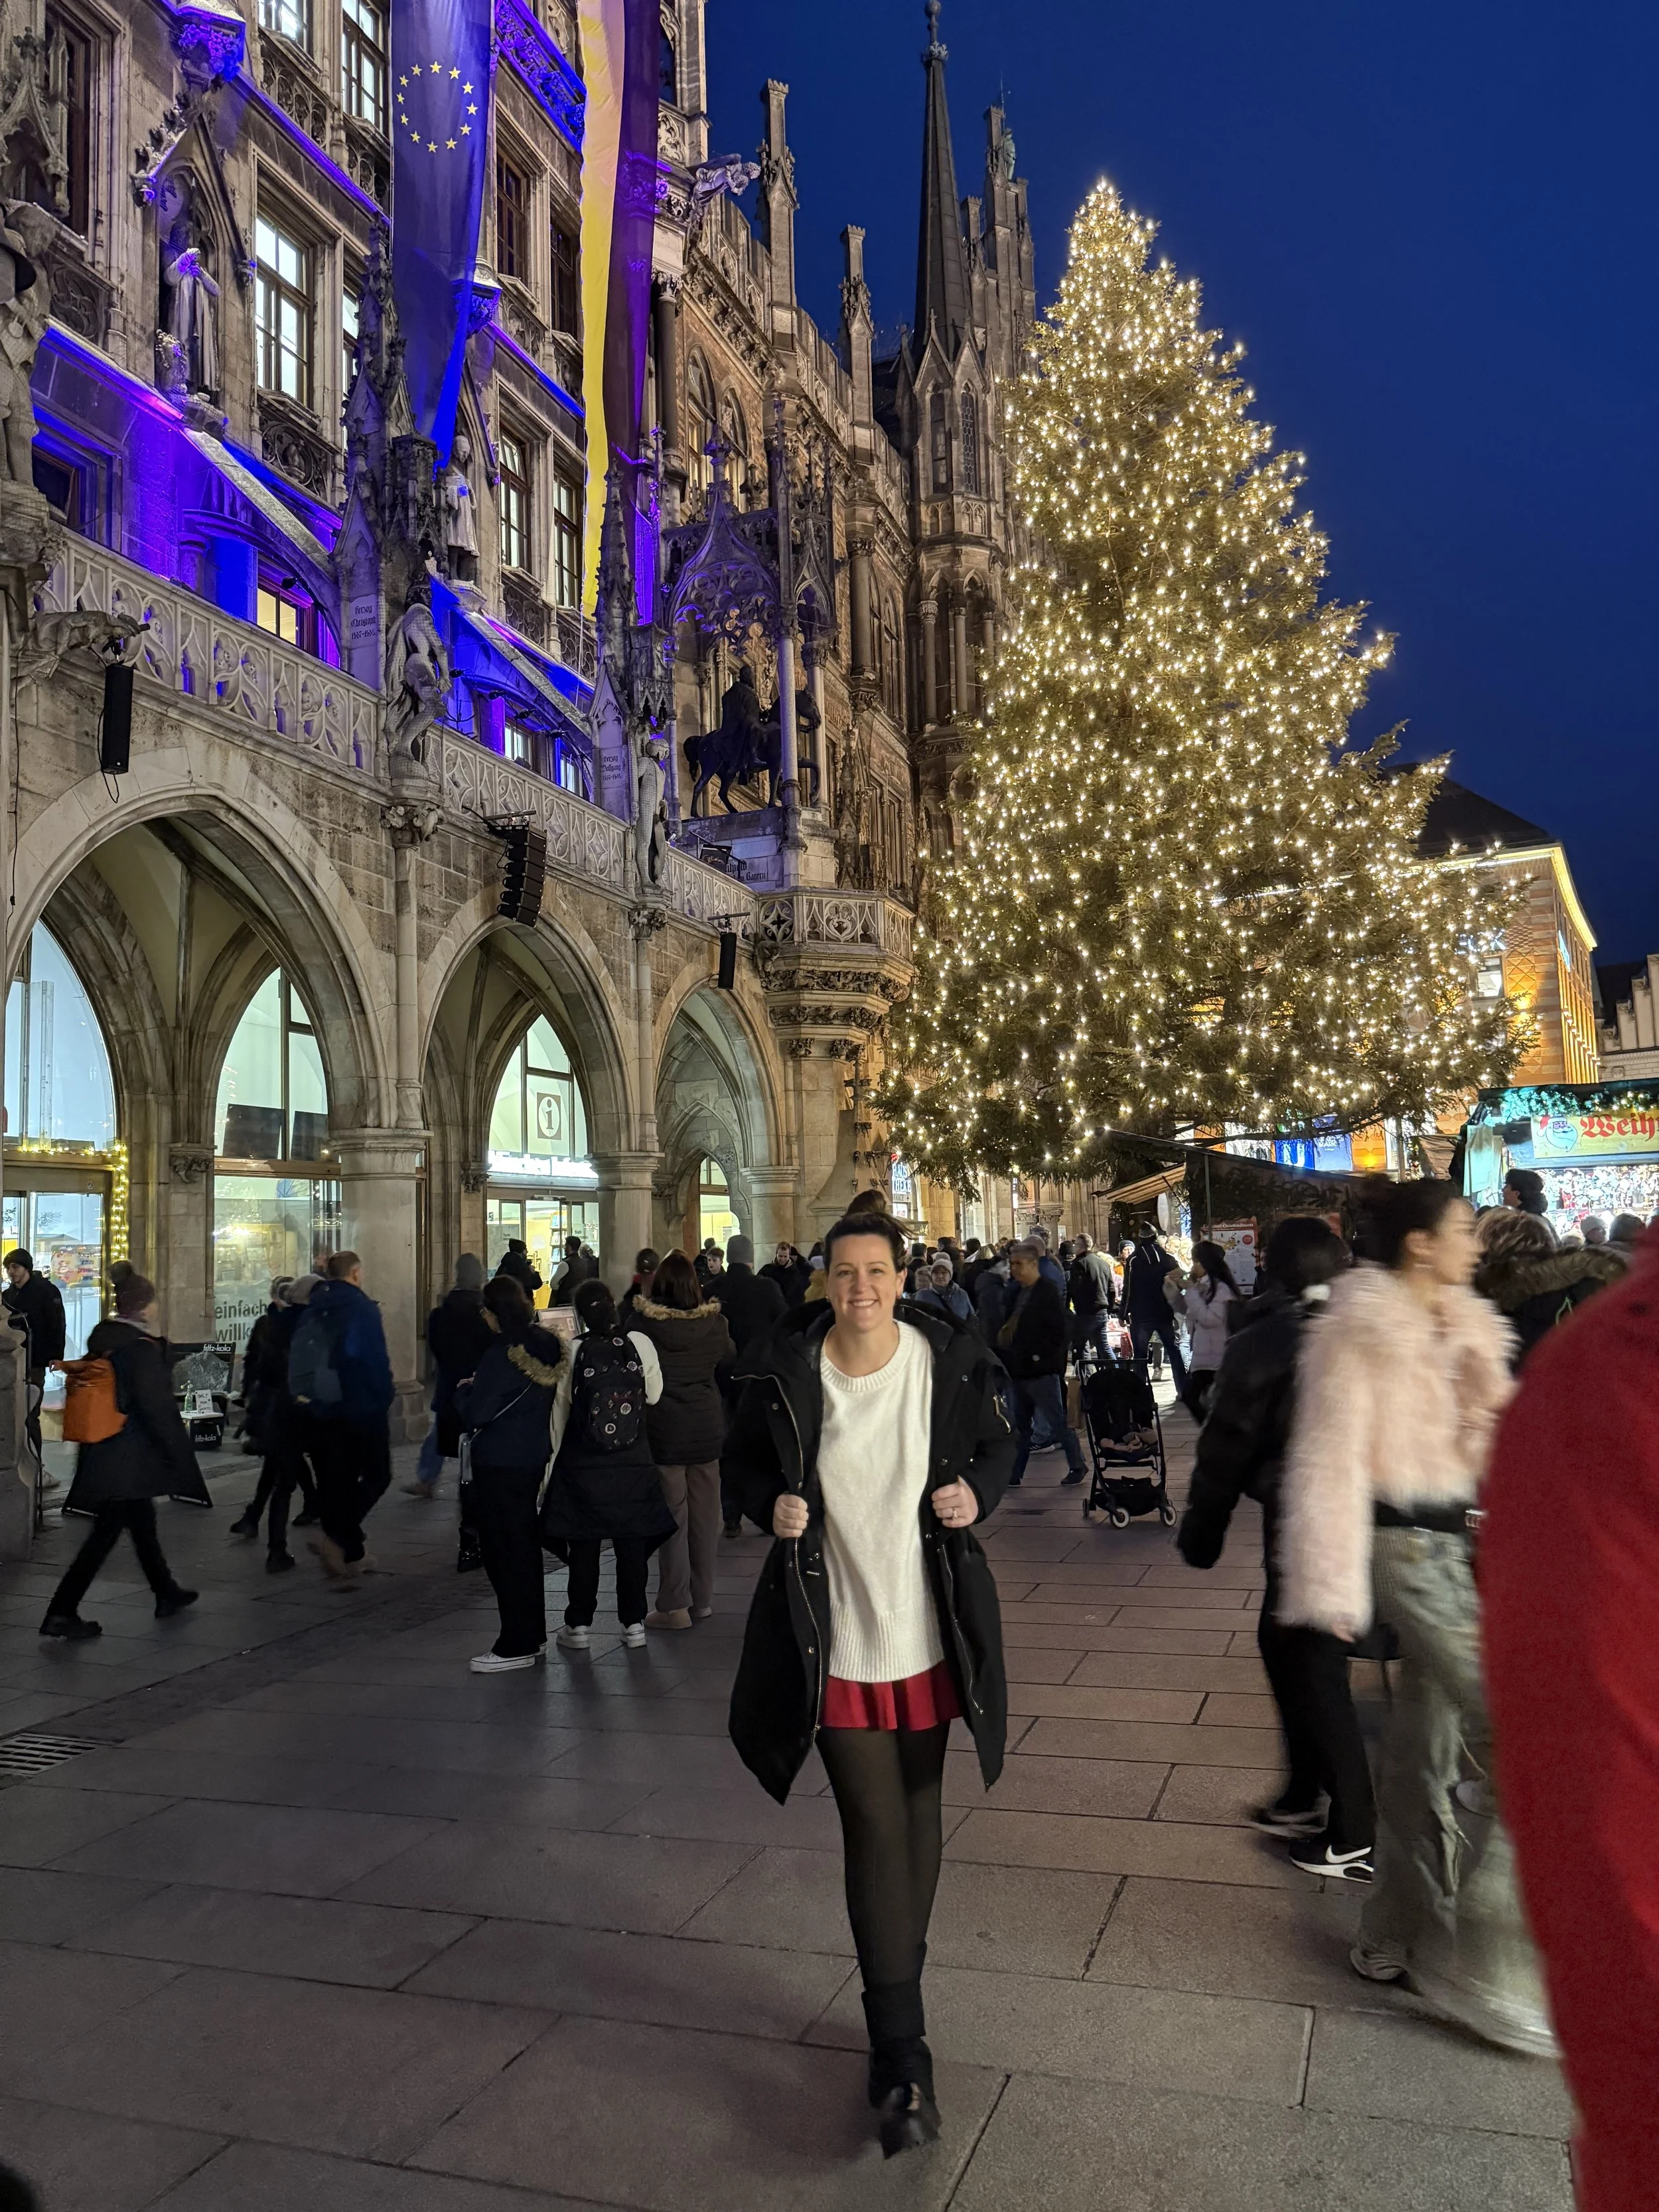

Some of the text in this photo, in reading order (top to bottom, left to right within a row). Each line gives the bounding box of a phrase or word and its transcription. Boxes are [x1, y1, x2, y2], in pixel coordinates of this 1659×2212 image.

[892, 1163, 908, 1178] HAUS
[892, 1179, 912, 1193] THEKE
[215, 1299, 268, 1319] einfach
[216, 1323, 252, 1342] willk
